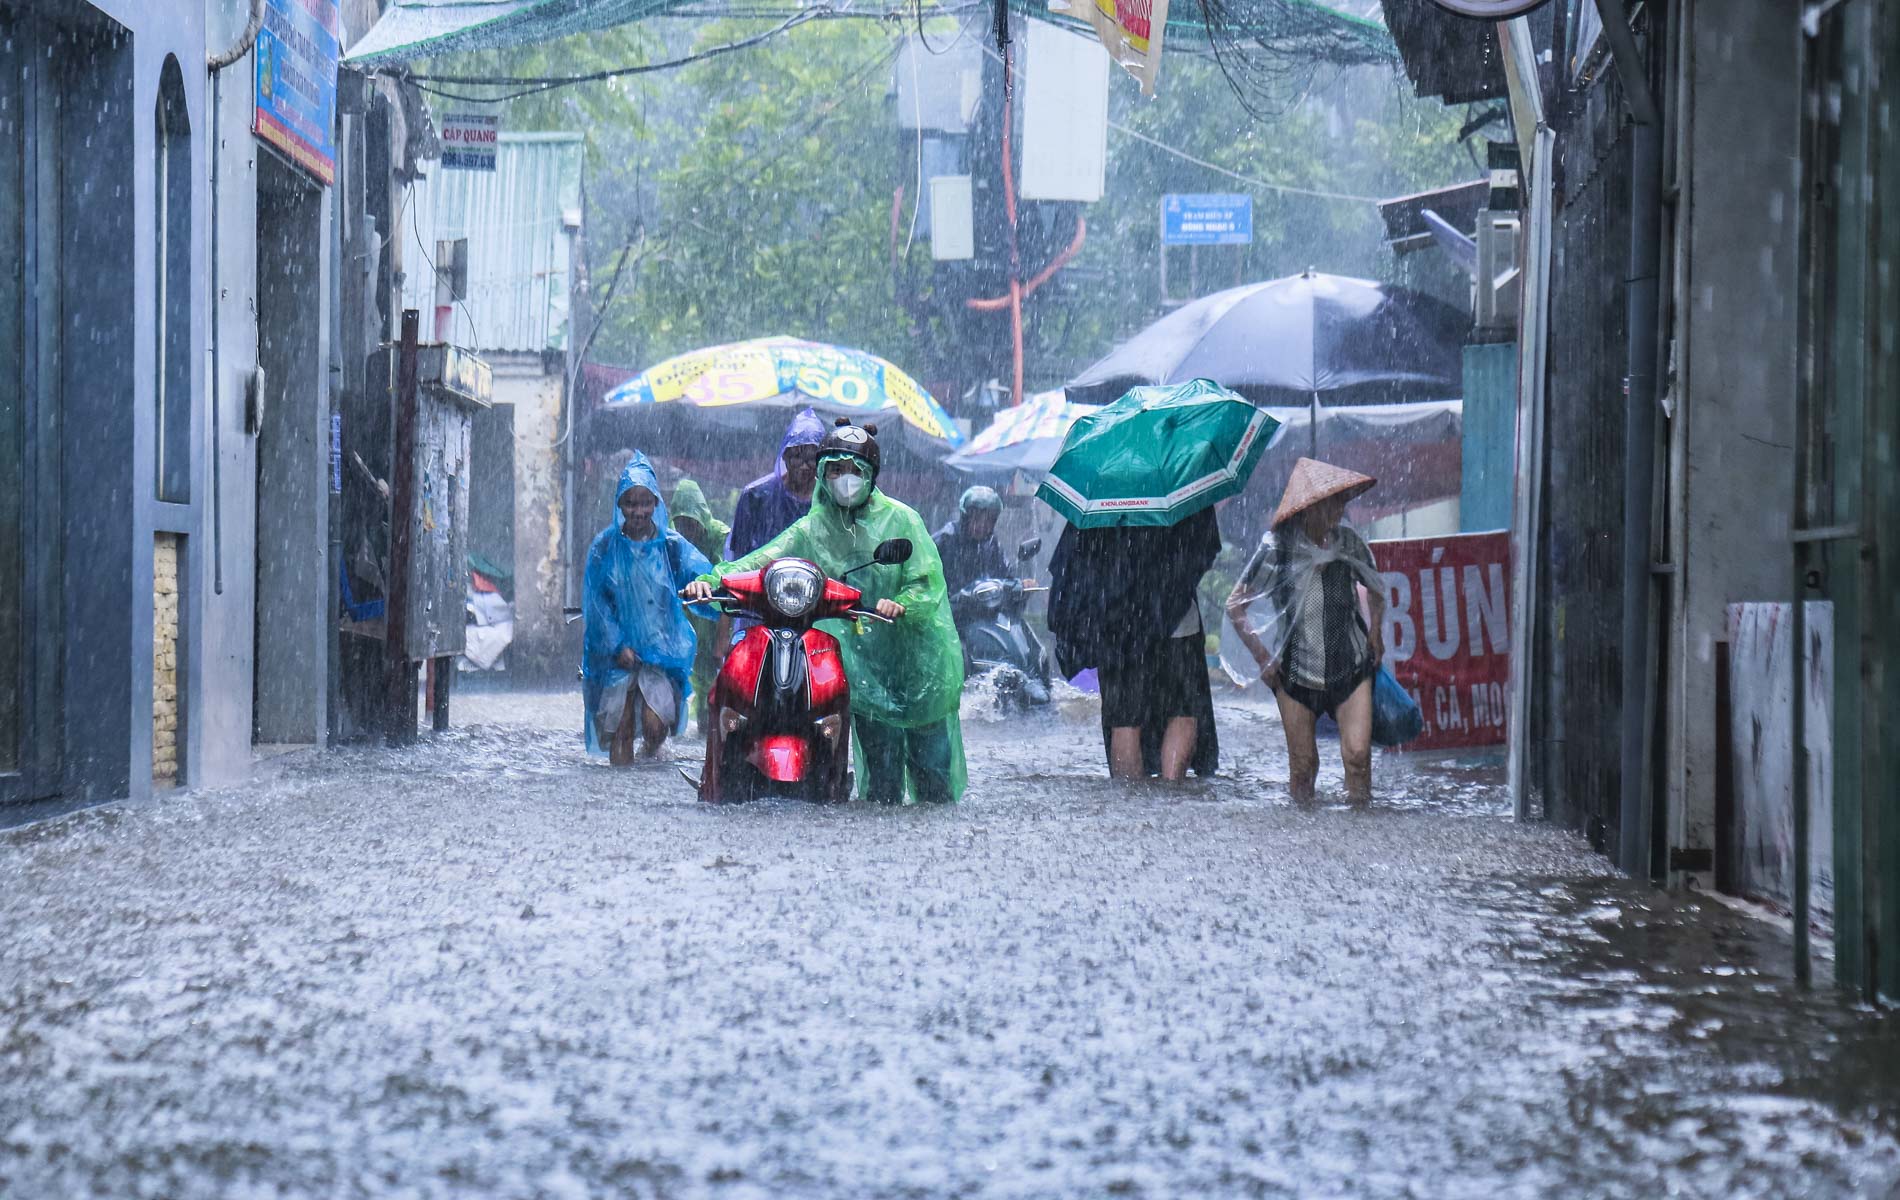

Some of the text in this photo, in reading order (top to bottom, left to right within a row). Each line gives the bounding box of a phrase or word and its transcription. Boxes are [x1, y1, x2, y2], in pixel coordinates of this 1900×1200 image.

[463, 128, 496, 144] QUANG
[796, 366, 869, 407] 50
[1100, 499, 1149, 507] KIENLONGBANK
[1382, 546, 1510, 662] BÚN
[1435, 675, 1469, 735] CÁ,
